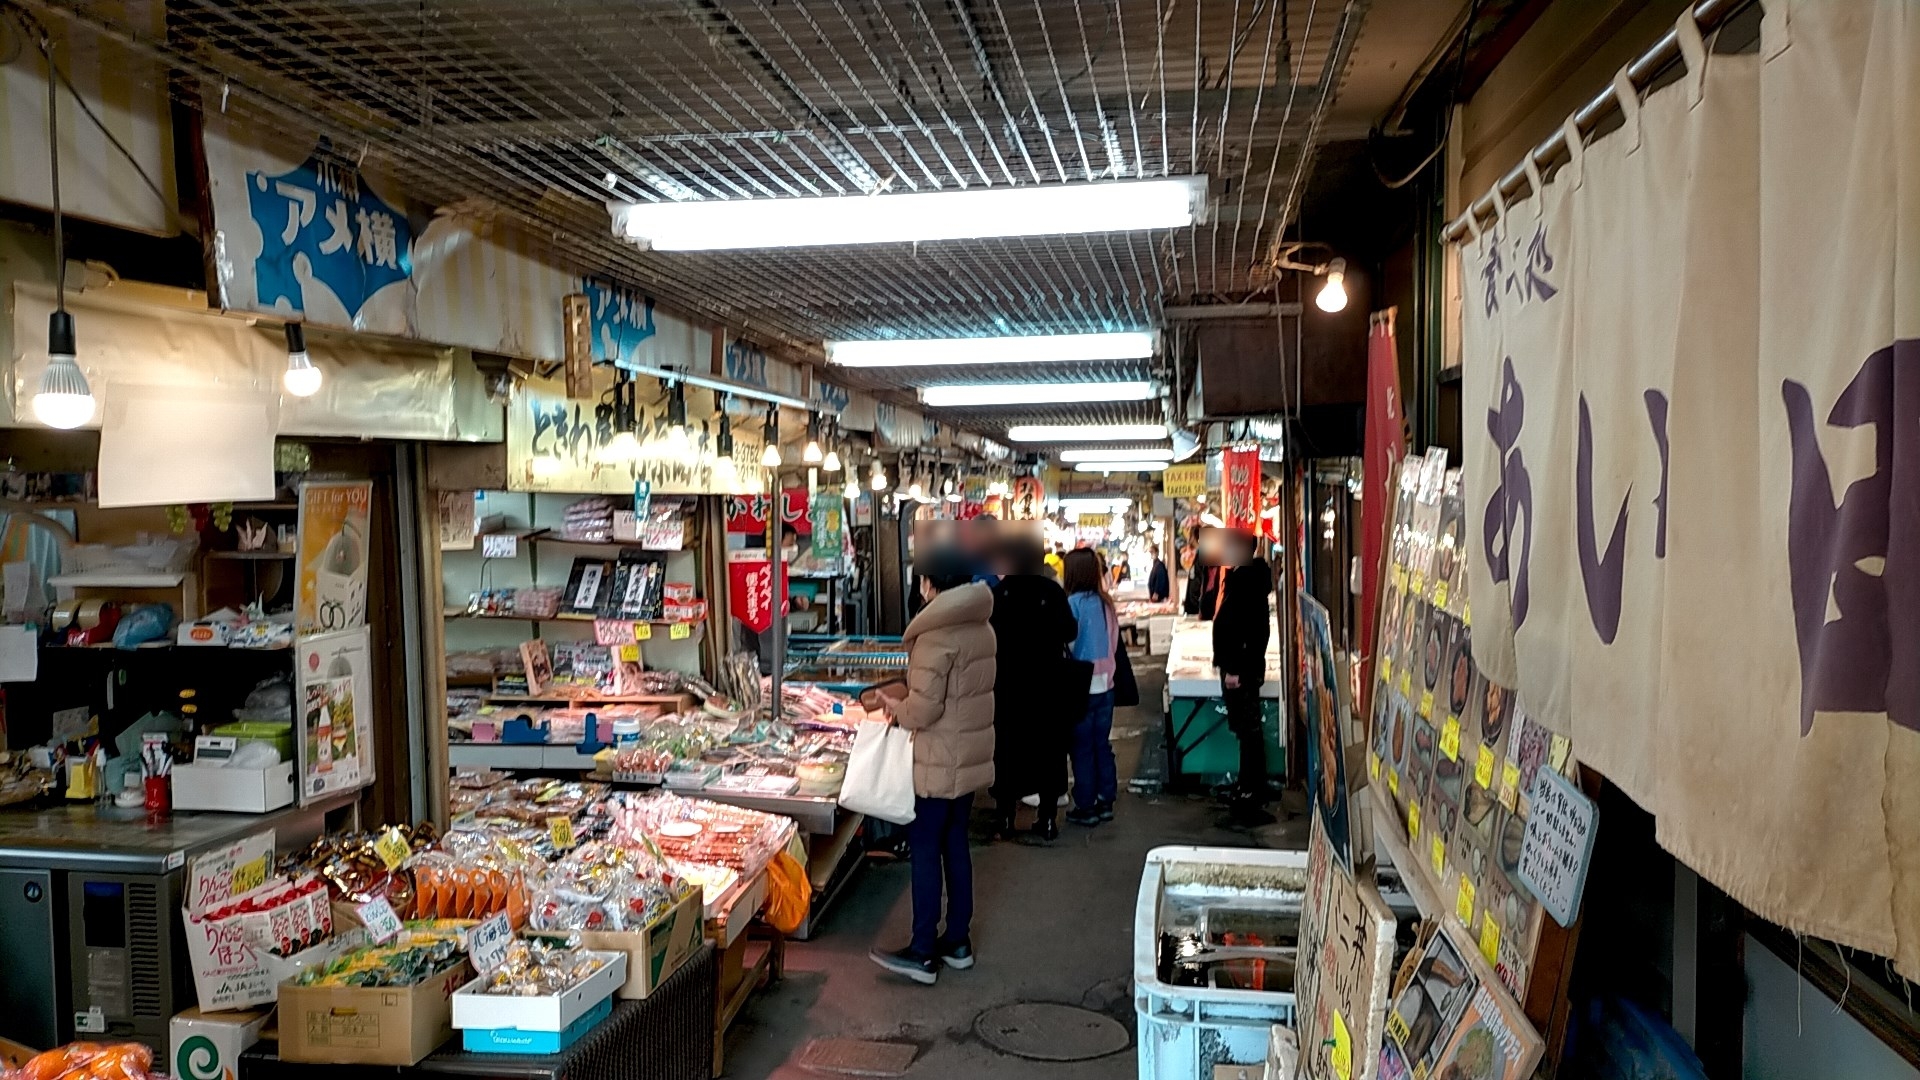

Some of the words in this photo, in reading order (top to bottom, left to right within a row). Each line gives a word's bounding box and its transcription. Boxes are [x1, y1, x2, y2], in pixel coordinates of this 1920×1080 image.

[275, 180, 398, 270] アメ横
[1165, 472, 1182, 482] TAX
[345, 487, 368, 503] YOU
[759, 563, 772, 611] ペイペイ
